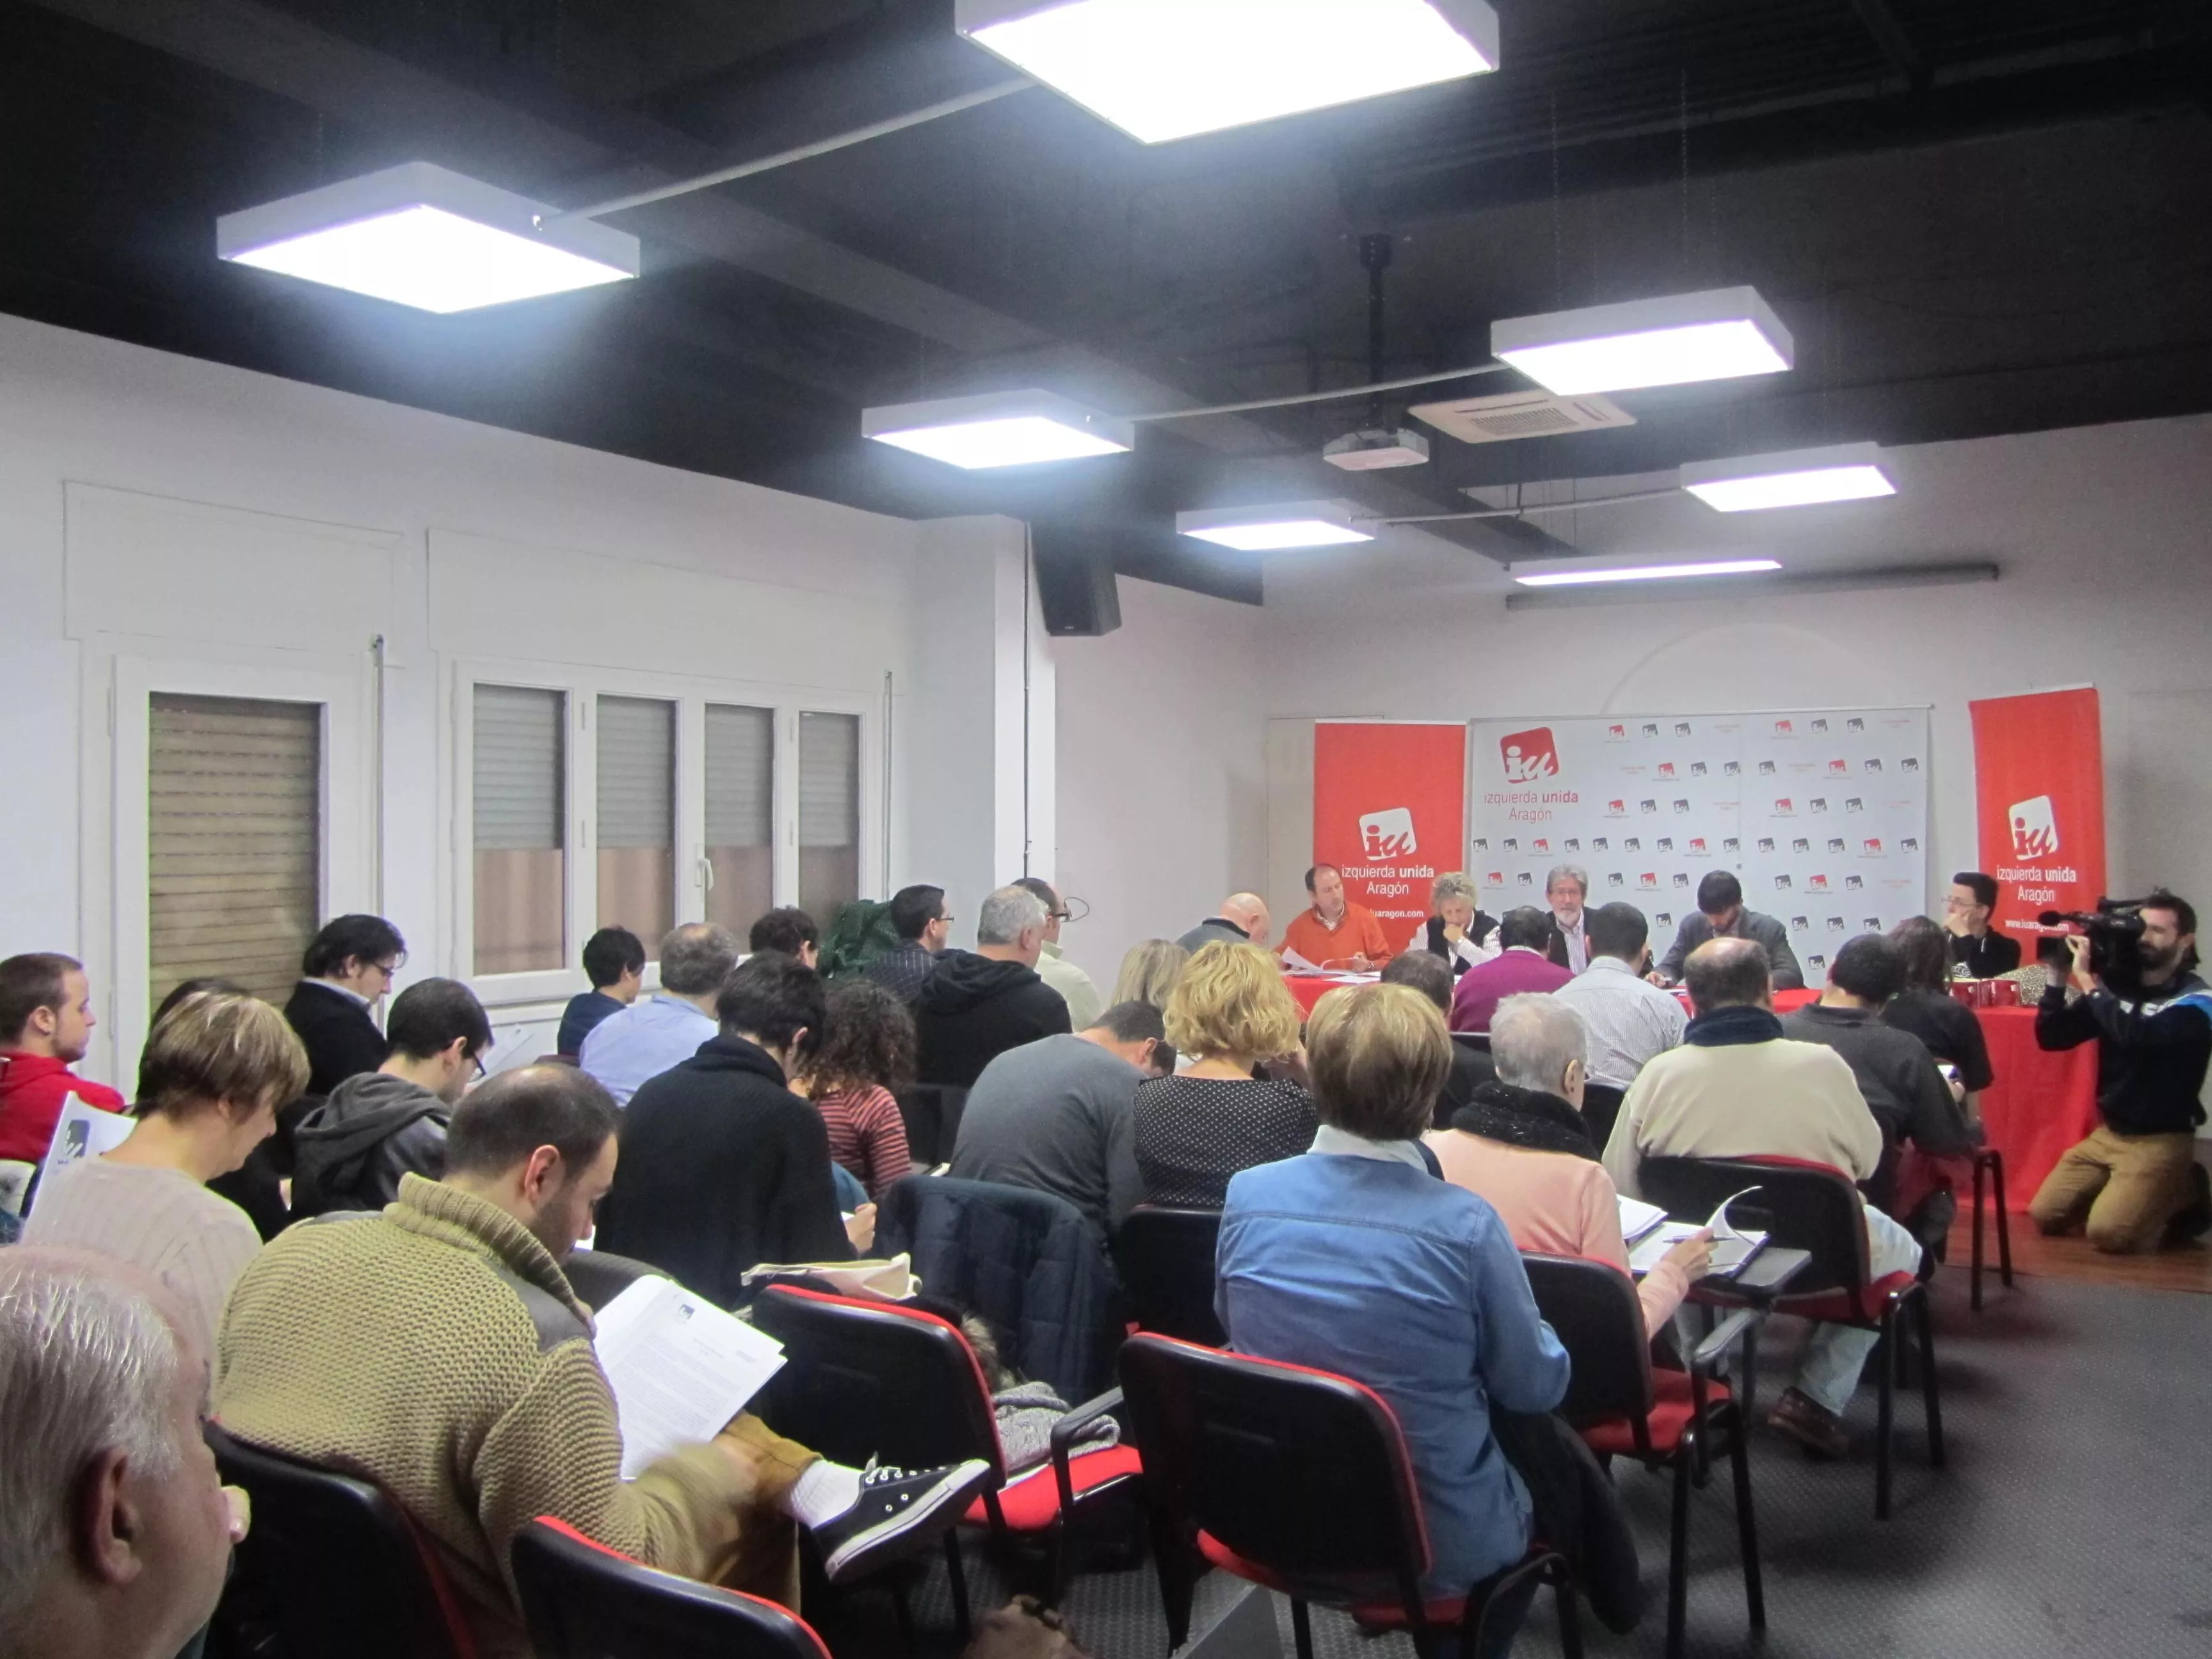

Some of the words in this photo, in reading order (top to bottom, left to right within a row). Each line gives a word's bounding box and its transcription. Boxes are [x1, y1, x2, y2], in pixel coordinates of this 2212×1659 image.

[1484, 790, 1537, 806] izquierda
[1542, 790, 1578, 803] unida
[1509, 807, 1551, 824] Aragón
[1342, 865, 1395, 881] izquierda
[1399, 865, 1434, 878] unida
[1996, 865, 2042, 883] izquierda
[2045, 866, 2076, 883] unida
[1366, 881, 1409, 897] Aragón
[2017, 886, 2054, 905] Aragón
